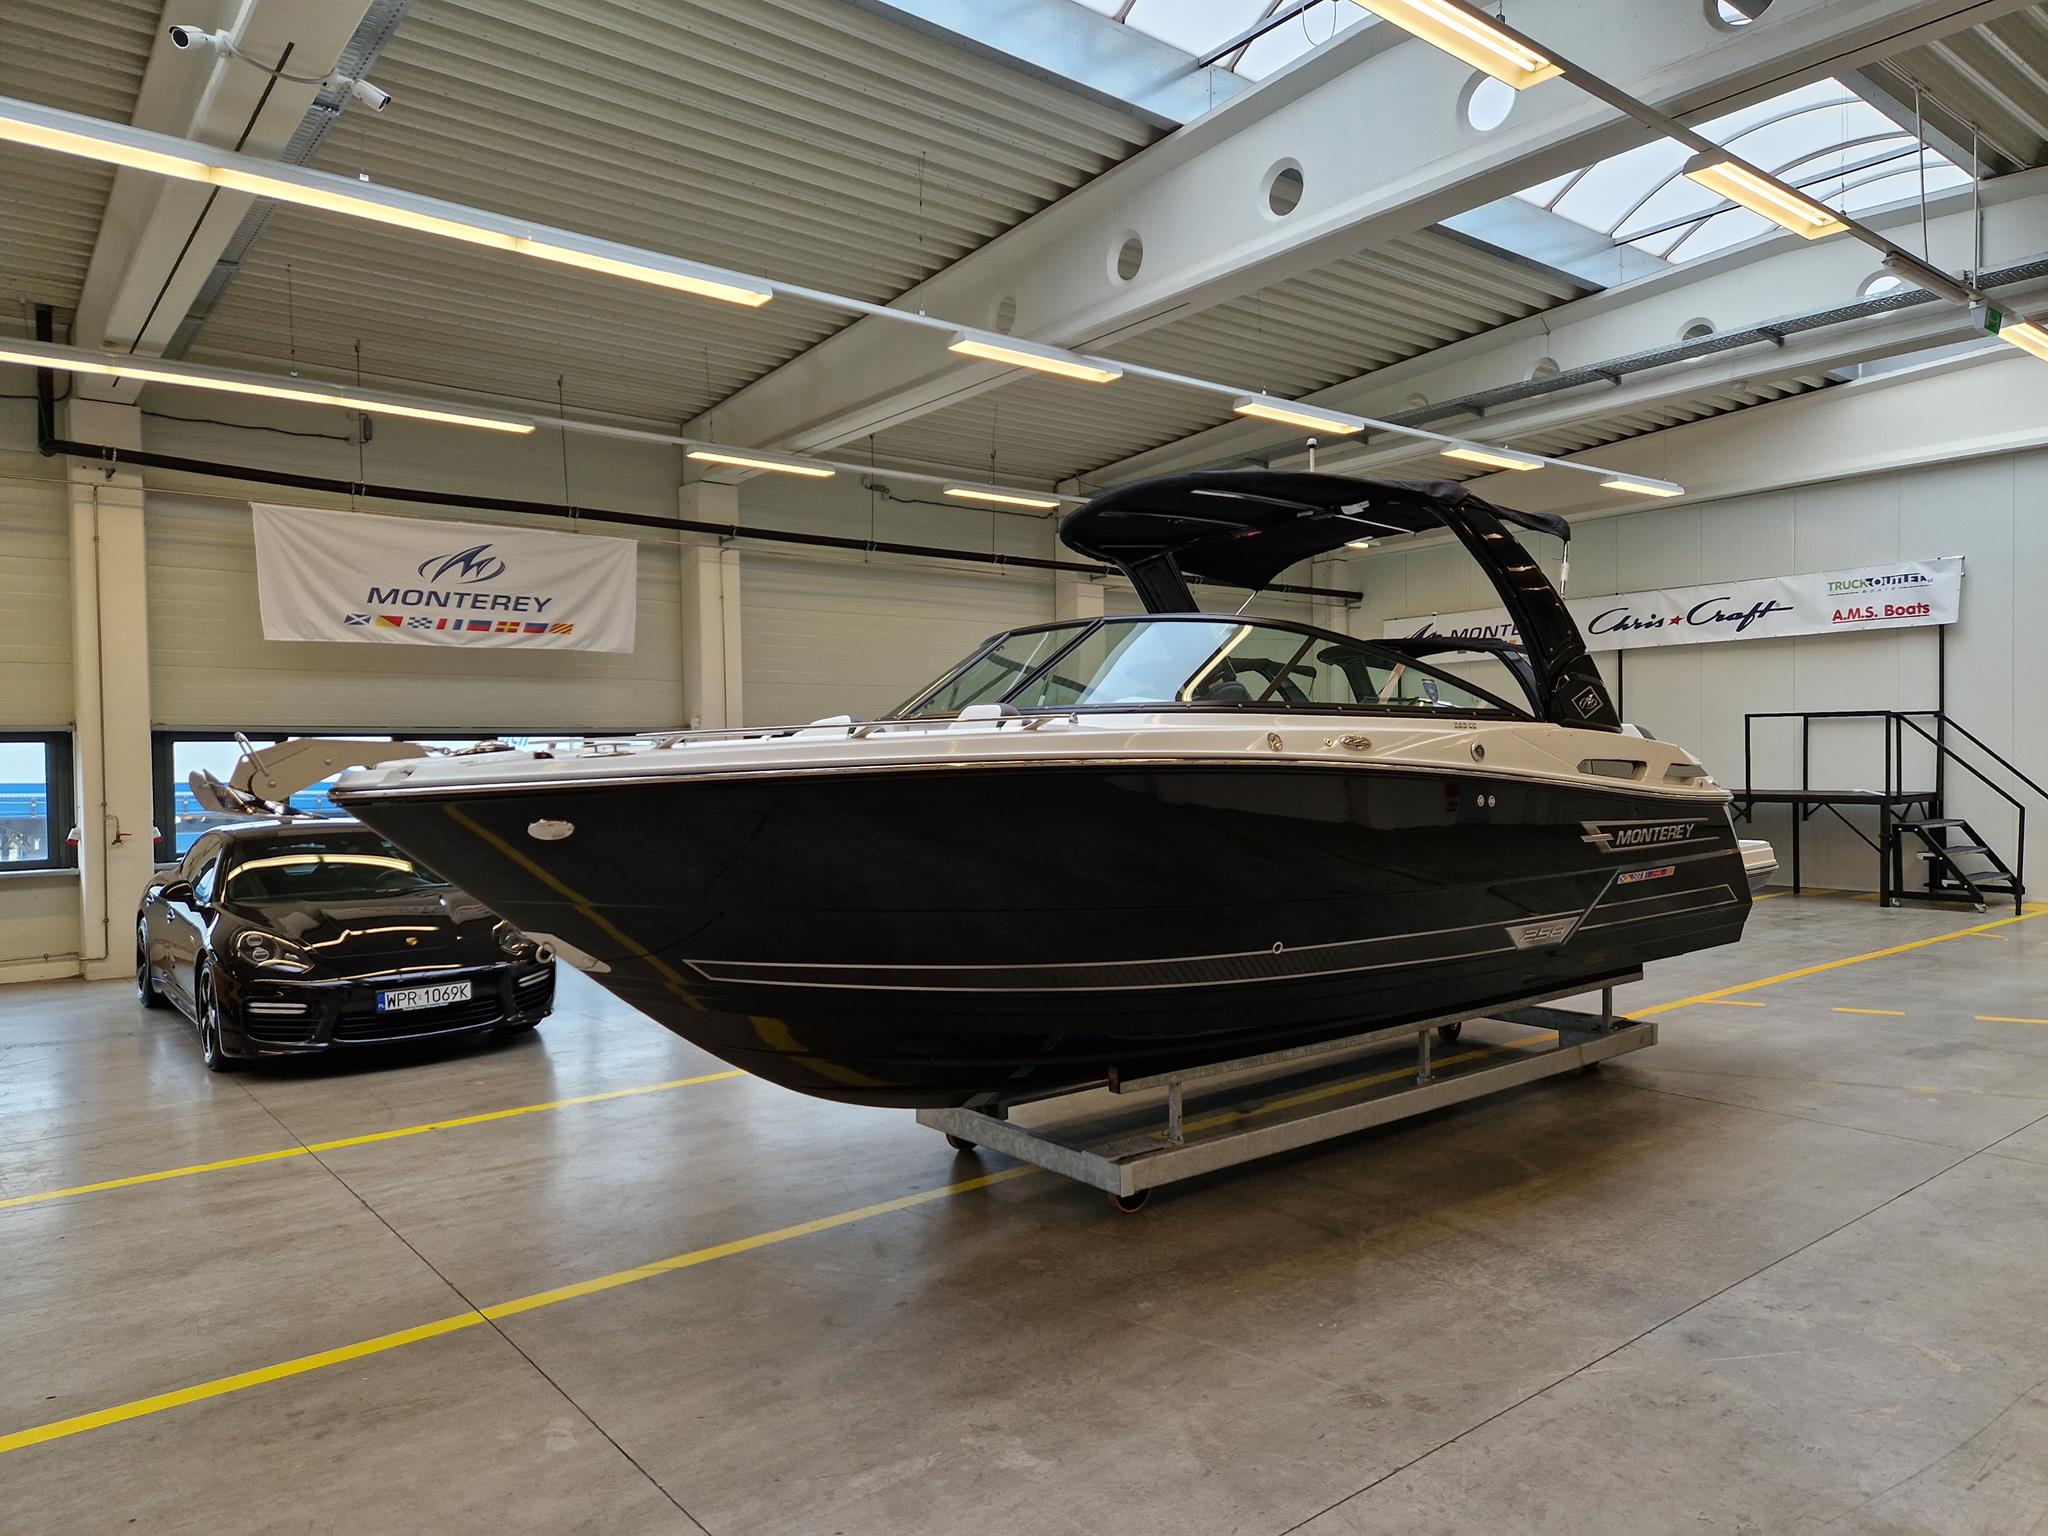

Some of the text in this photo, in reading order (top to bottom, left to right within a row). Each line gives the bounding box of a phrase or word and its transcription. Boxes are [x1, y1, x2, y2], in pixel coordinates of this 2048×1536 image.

[366, 586, 552, 613] MONTEREY
[1588, 597, 1794, 635] Chris Craft
[1832, 602, 1931, 622] A.M.S. Boats
[1450, 623, 1521, 639] MONTE
[1616, 823, 1695, 846] MONTEREY
[386, 991, 417, 1009] WPR
[424, 985, 469, 1004] 1069K
